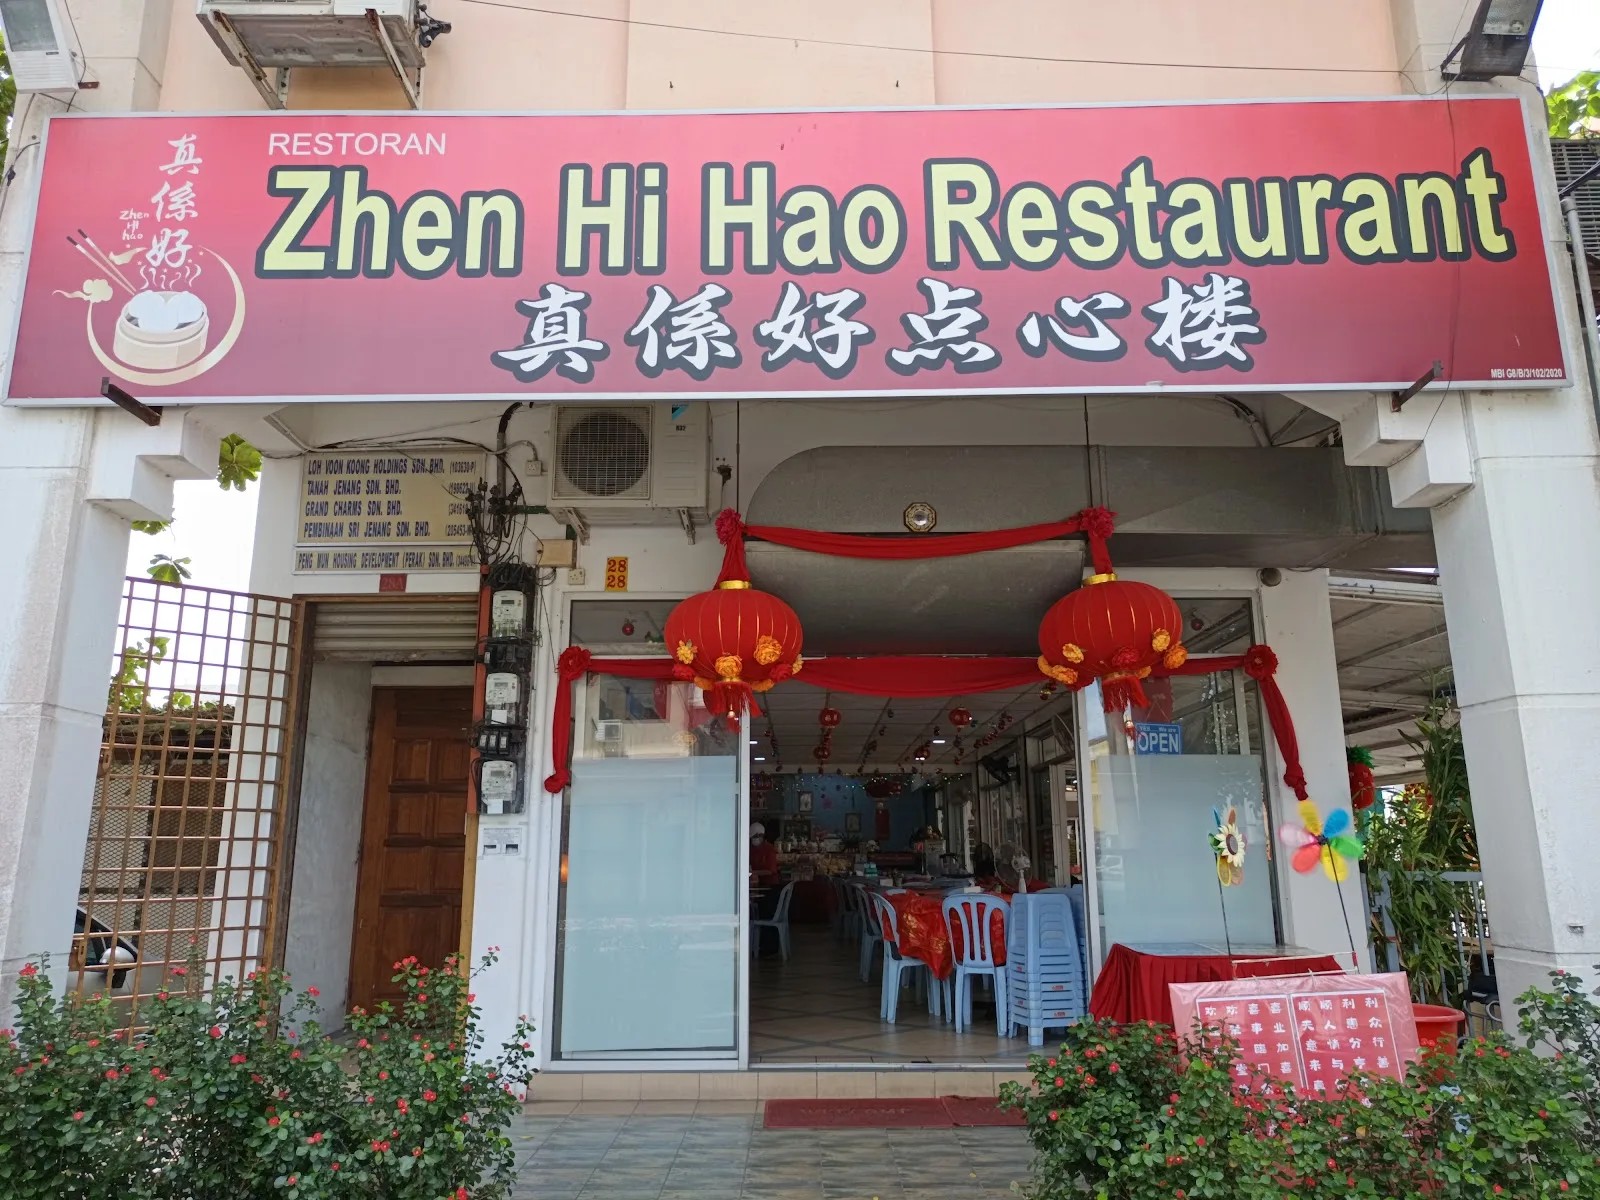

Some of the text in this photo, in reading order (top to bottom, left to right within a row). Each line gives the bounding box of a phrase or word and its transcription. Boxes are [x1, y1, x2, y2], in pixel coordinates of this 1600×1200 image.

[268, 132, 446, 156] RESTORAN
[120, 208, 150, 220] Zhen
[262, 152, 1510, 273] Zhen Hi Hao Restaurant
[494, 273, 1264, 379] 真係好点心楼
[1490, 369, 1505, 378] MBI
[308, 460, 321, 475] LOH
[346, 459, 369, 474] KOONG
[373, 459, 408, 474] HOLDINGS
[429, 458, 445, 474] BHD.
[308, 480, 329, 495] TANAH
[333, 480, 361, 495] JENANG
[366, 480, 382, 495] SDN.
[385, 479, 402, 494] BHD.
[305, 501, 329, 516] GRAND
[333, 501, 362, 516] CHARMS
[367, 500, 383, 516] SDN.
[386, 500, 403, 516] BHD.
[303, 522, 344, 538] PEMBINAAN
[348, 522, 360, 537] SRI
[364, 521, 391, 537] JENANG
[396, 521, 411, 537] SDN.
[414, 521, 431, 537] BHD.
[298, 552, 313, 569] PENG
[333, 552, 357, 568] HOUSING
[361, 551, 400, 568] DEVELOPMENT
[402, 551, 425, 568] (PERAK)
[428, 551, 441, 568] SDN.
[442, 551, 455, 568] BHD.
[607, 560, 627, 572] 28
[607, 575, 626, 588] 28
[1138, 732, 1179, 753] OPEN
